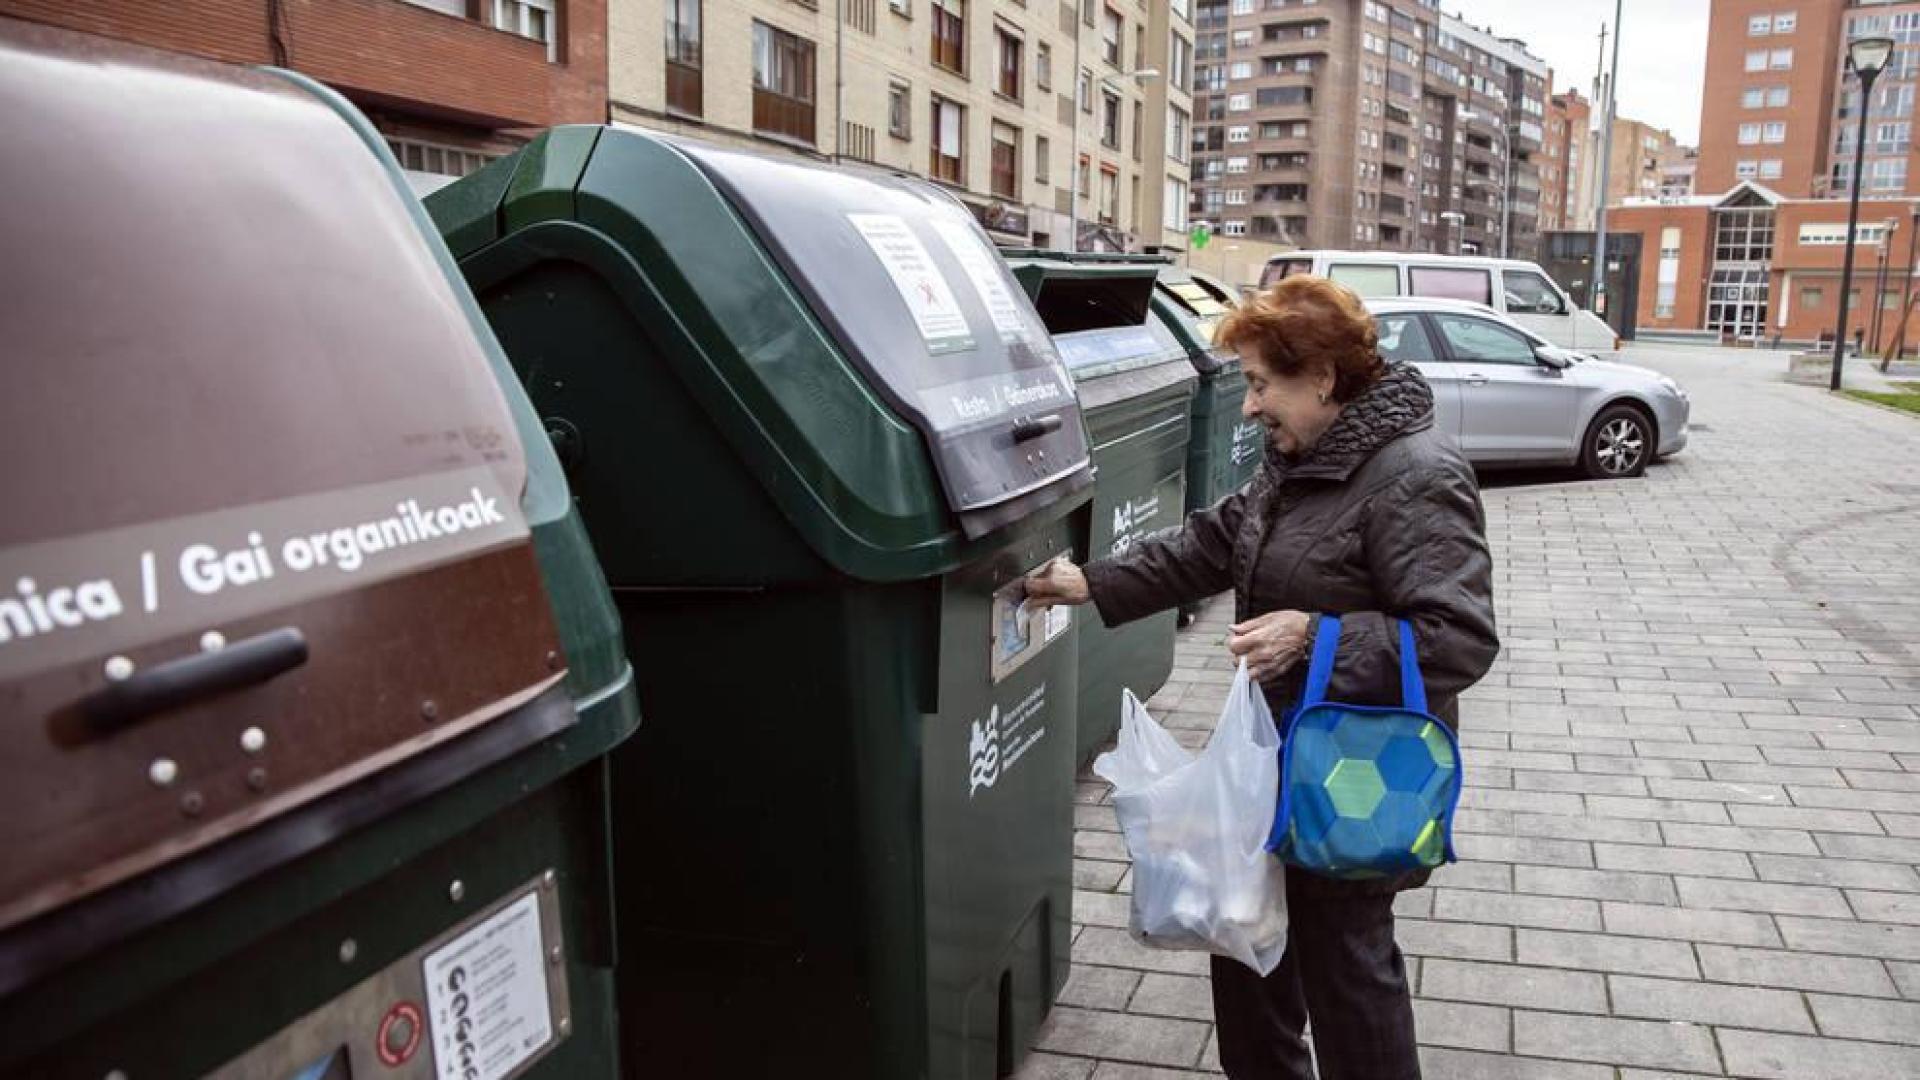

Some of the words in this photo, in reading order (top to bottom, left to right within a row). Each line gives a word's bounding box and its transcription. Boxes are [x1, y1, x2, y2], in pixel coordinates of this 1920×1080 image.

[141, 552, 158, 613] /
[179, 532, 273, 595] Gai
[282, 487, 504, 571] organikoak
